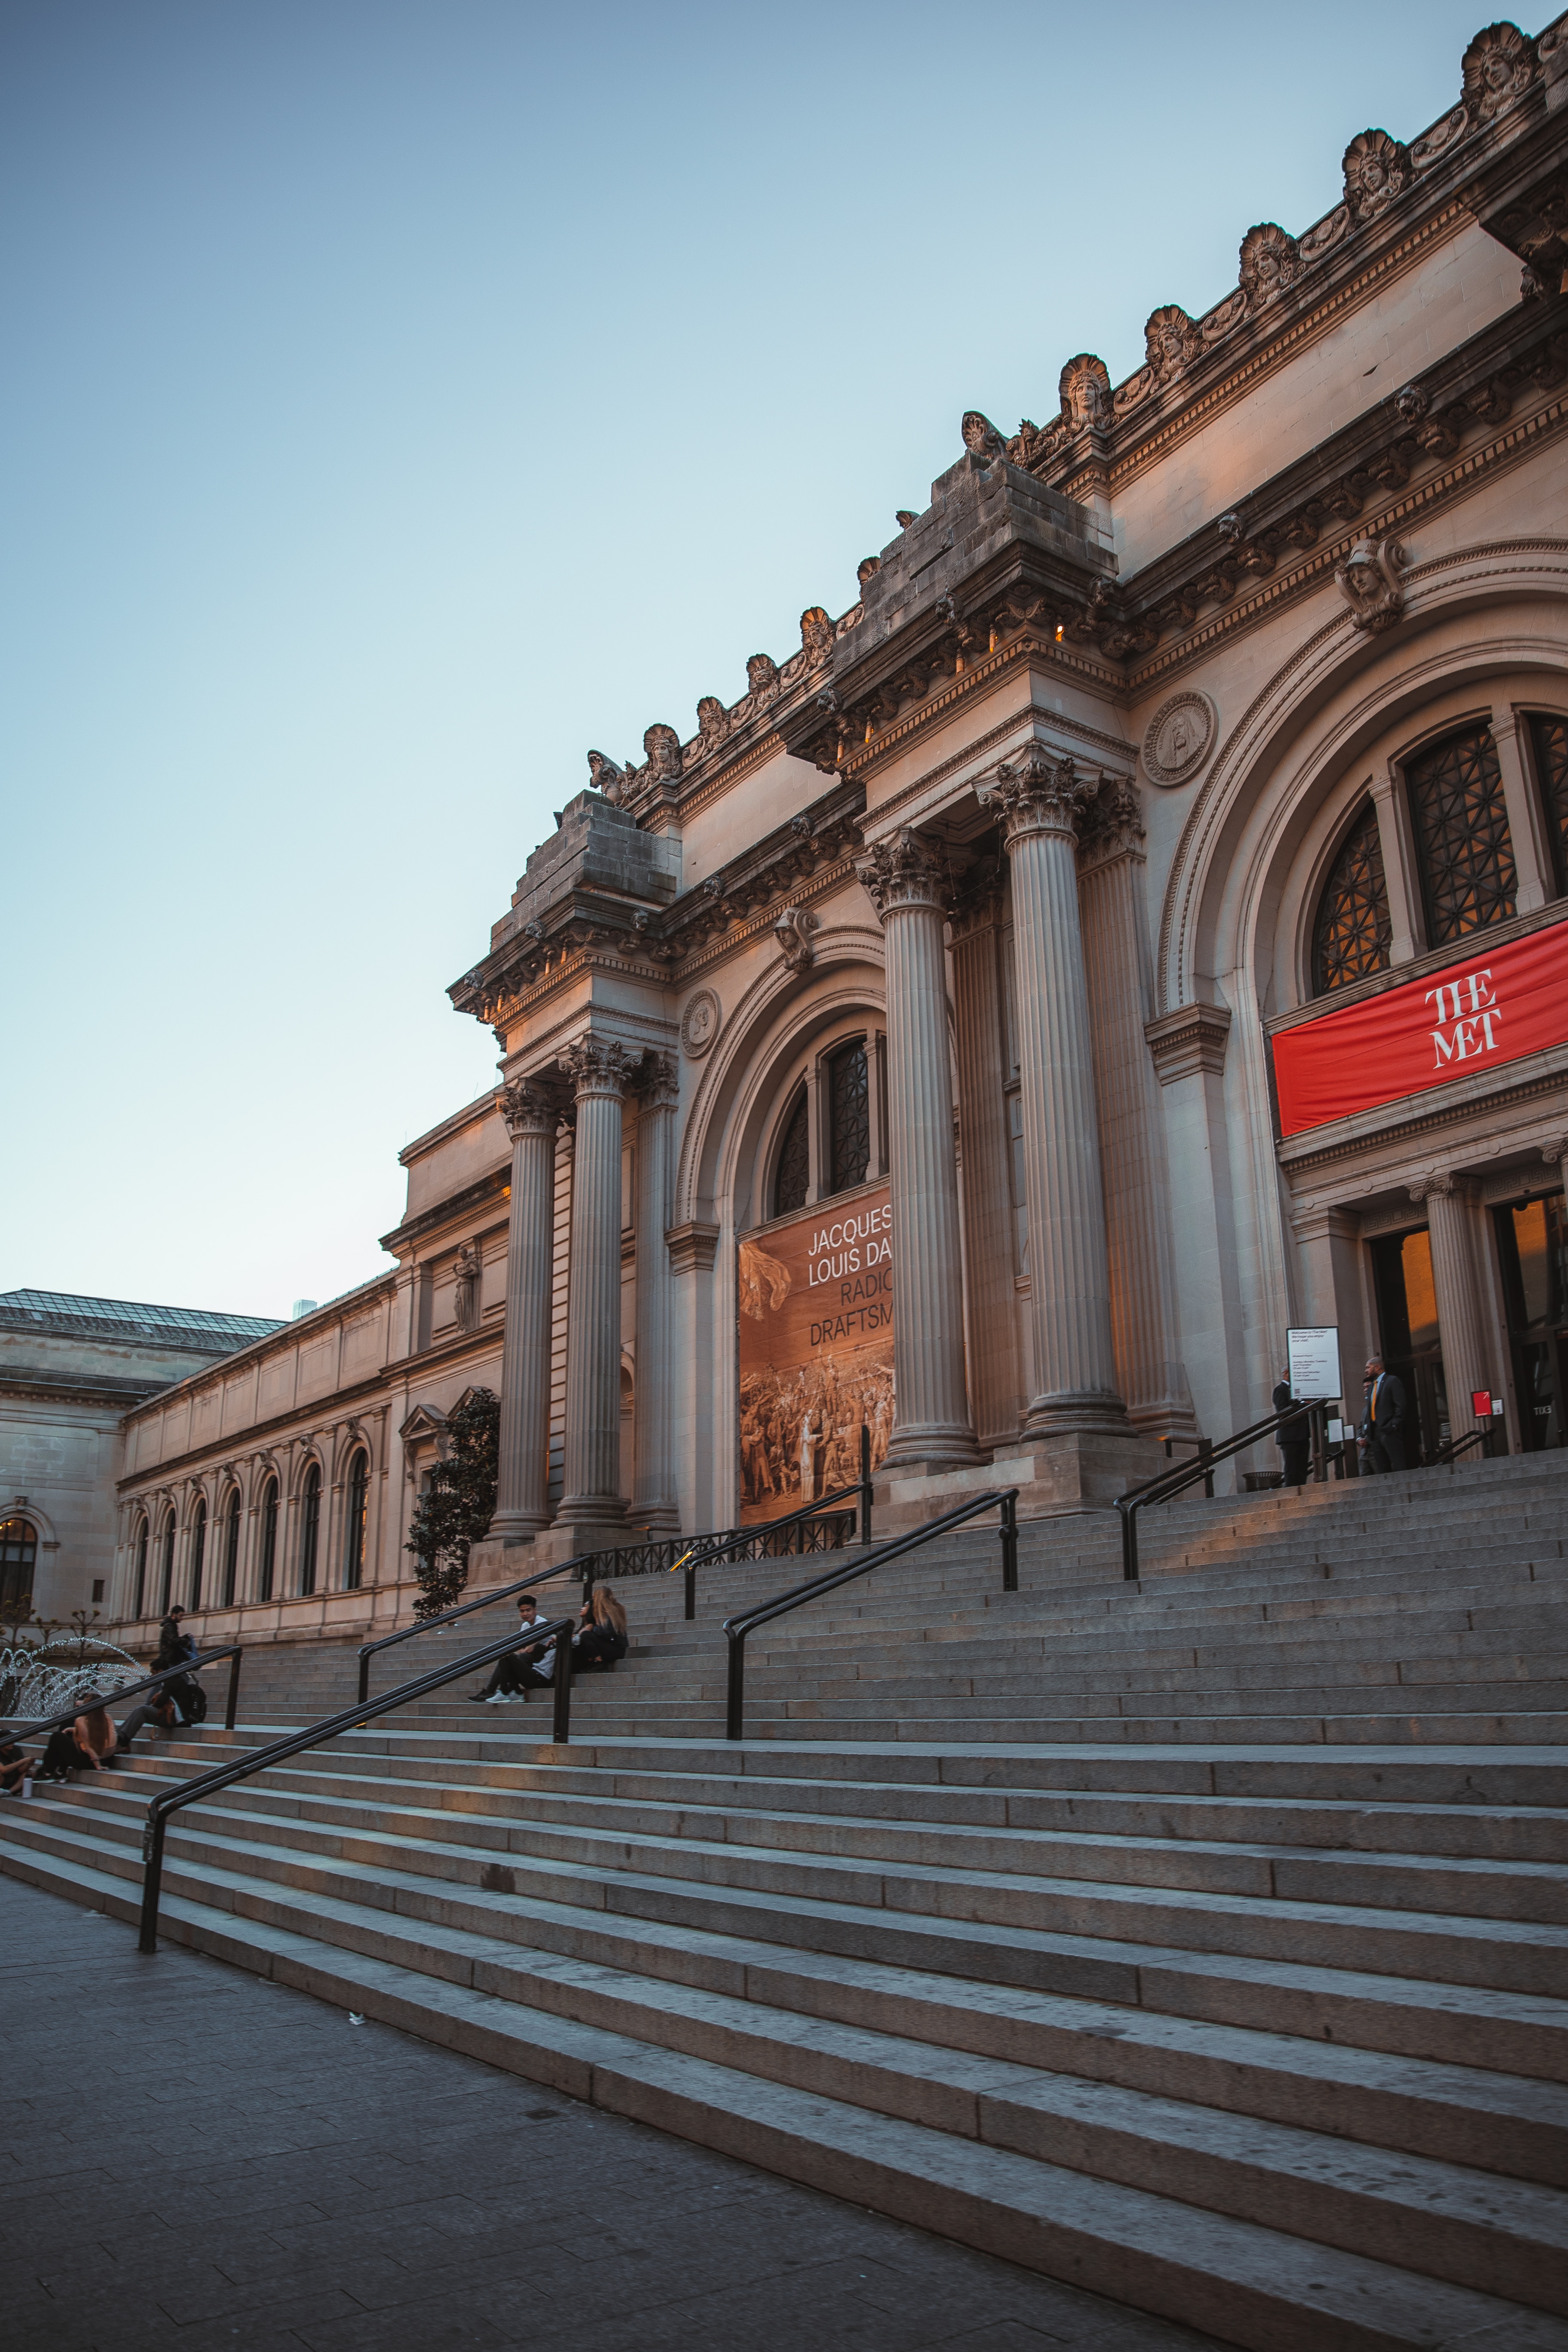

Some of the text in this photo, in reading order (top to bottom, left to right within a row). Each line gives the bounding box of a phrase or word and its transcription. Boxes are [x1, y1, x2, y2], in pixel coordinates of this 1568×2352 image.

[1425, 968, 1496, 1026] THE
[1428, 1008, 1502, 1069] MET
[808, 1204, 891, 1256] JACQUES
[809, 1236, 892, 1286] LOUIS DA
